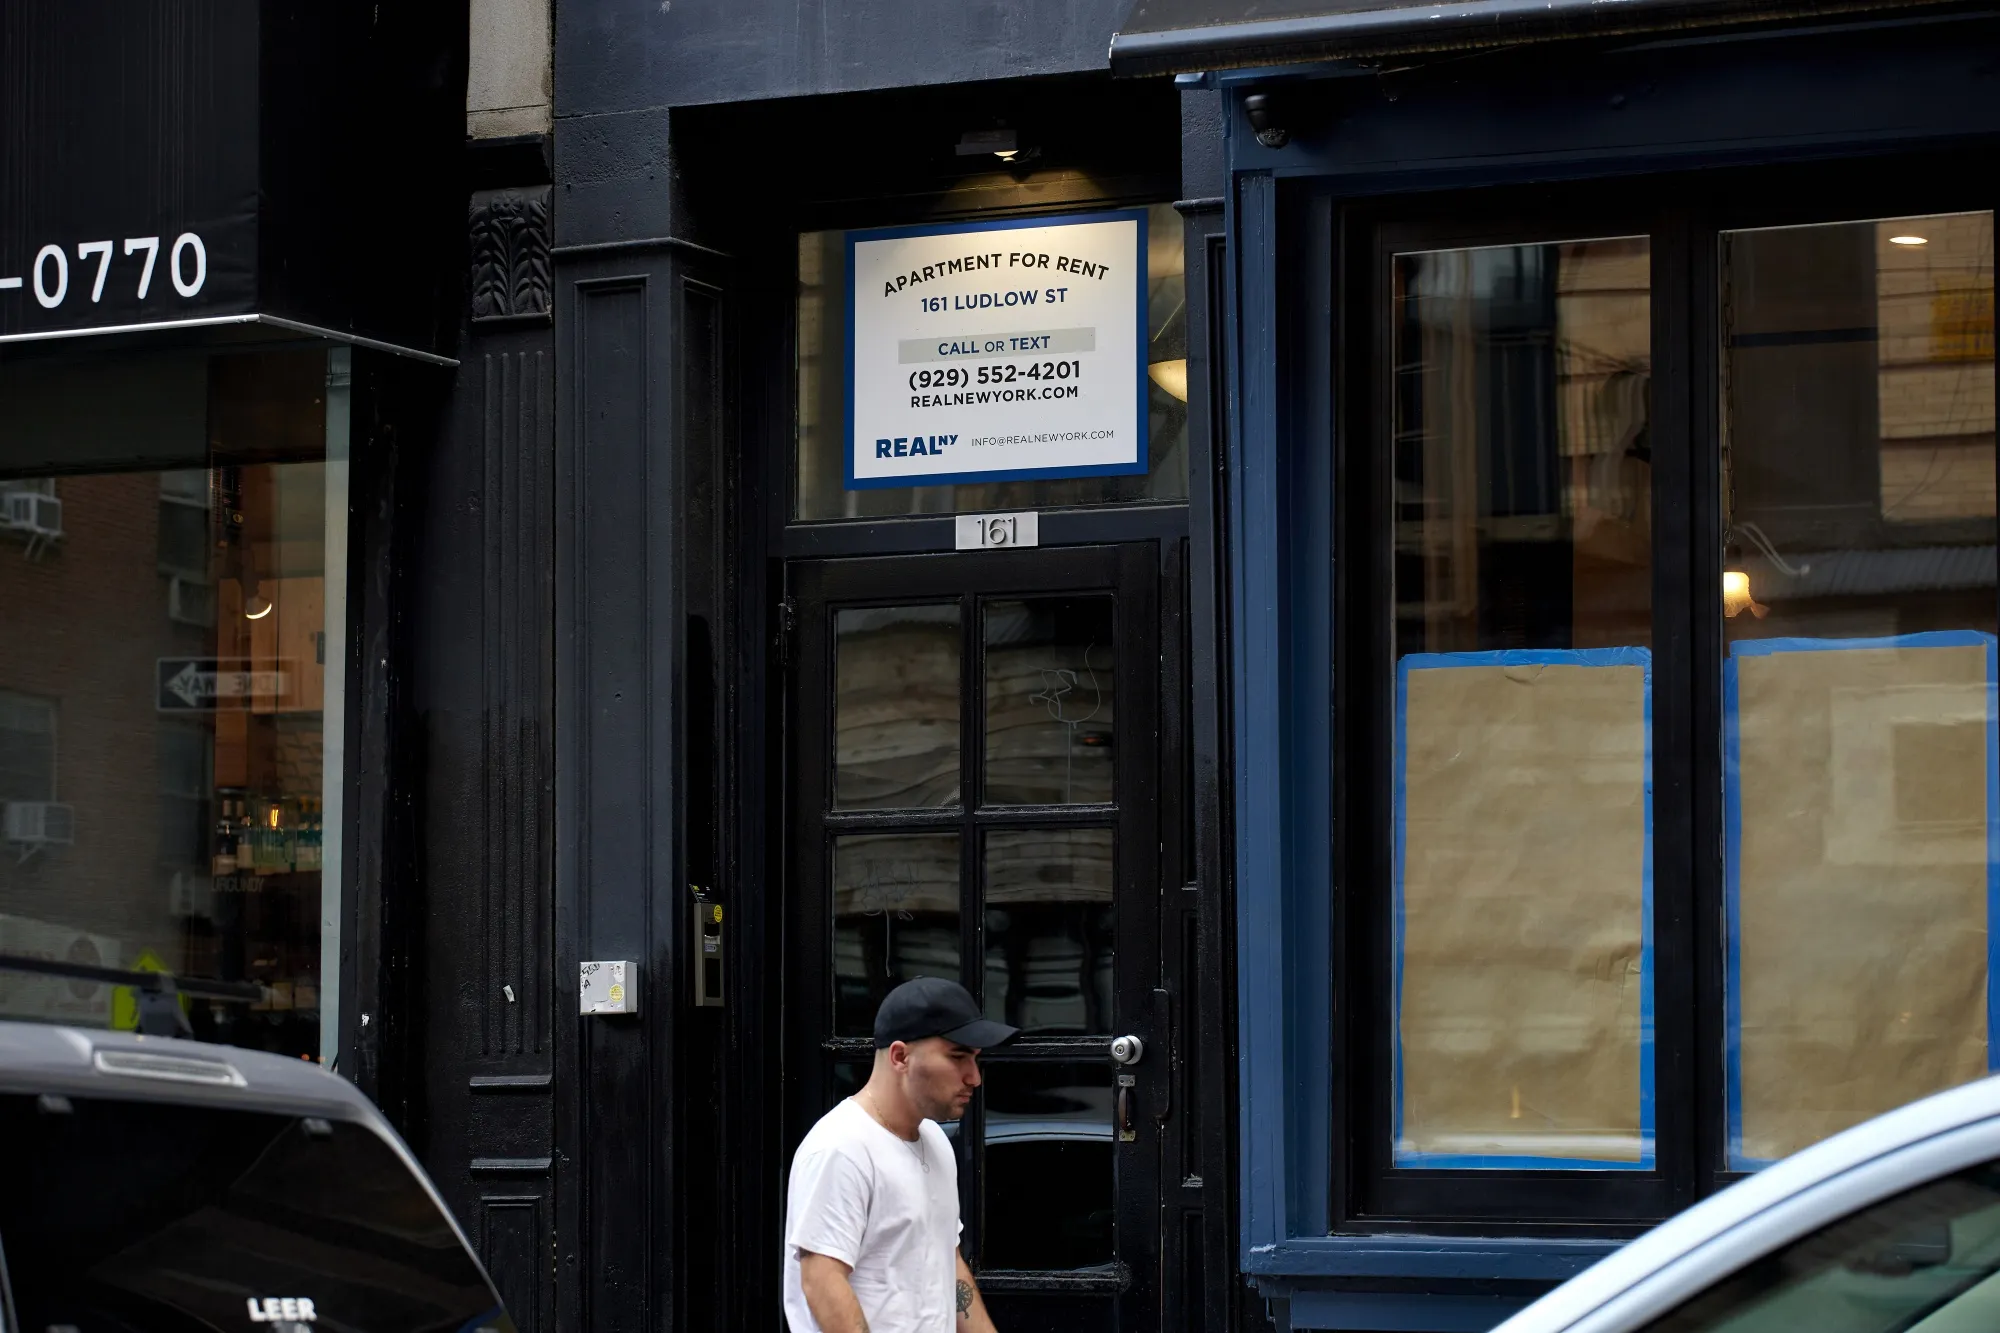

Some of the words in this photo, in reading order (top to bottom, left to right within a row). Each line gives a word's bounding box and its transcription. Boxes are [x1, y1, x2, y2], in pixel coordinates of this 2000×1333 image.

[884, 253, 1002, 297] APARTMENT
[1009, 253, 1050, 268] FOR
[1056, 255, 1109, 281] RENT
[921, 296, 948, 313] 161
[955, 290, 1038, 311] LUDLOW
[1045, 288, 1068, 304] ST
[938, 340, 980, 356] CALL
[984, 341, 1005, 353] OR
[1009, 336, 1051, 351] TEXT
[909, 367, 969, 392] (929)
[977, 360, 1080, 384] 552-4201
[911, 385, 1079, 408] REALNEWYORK.COM
[971, 430, 1115, 447] INFO@REALNEWYORK.COM
[976, 516, 1017, 544] 161
[246, 1297, 318, 1322] LEER
